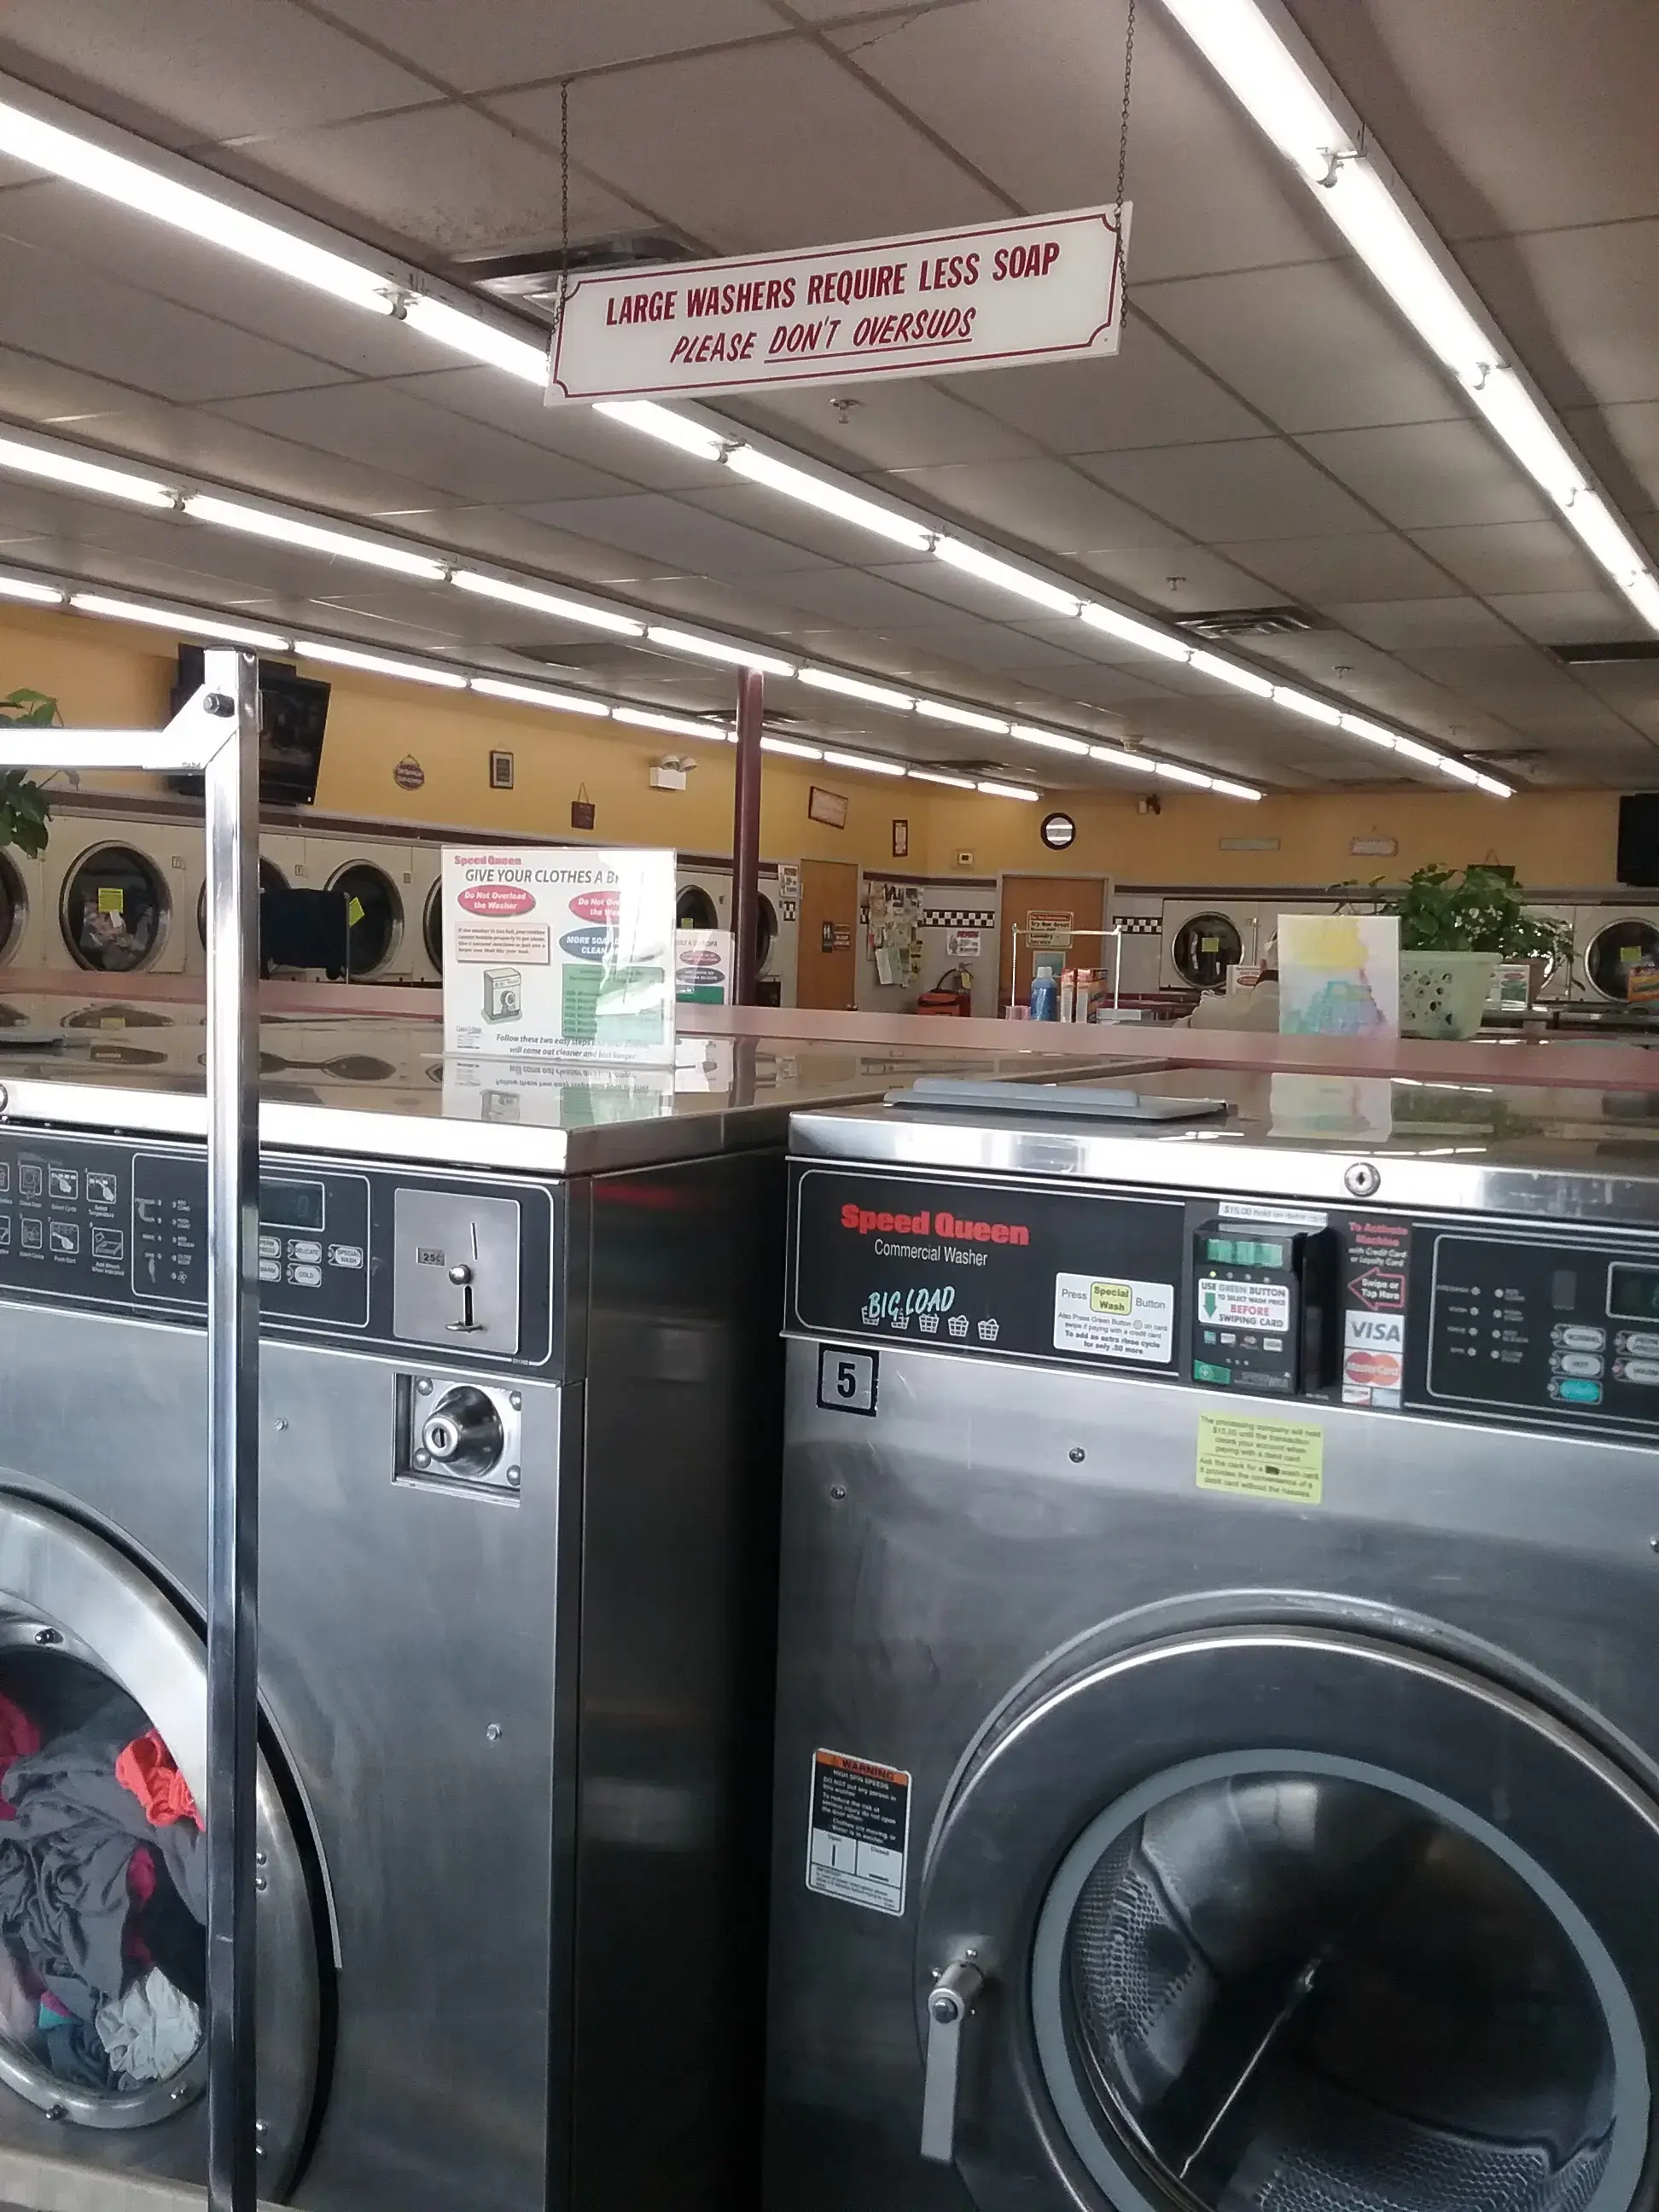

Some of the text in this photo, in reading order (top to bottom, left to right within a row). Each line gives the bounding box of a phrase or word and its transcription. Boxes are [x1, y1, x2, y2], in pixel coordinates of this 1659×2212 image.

[606, 242, 1060, 326] LARGE WASHERS REQUIRE LESS SOAP
[670, 307, 976, 364] PLEASE DON'T OVERSUDS
[455, 855, 521, 866] Speed Queen
[465, 869, 602, 883] GIVE YOUR CLOTHES A
[567, 935, 590, 944] MORE
[521, 1034, 538, 1044] these
[540, 1036, 553, 1045] two
[555, 1038, 570, 1047] easy
[613, 1052, 636, 1061] longer
[1225, 1206, 1251, 1215] $15.00
[841, 1203, 1030, 1245] Speed Queen
[295, 1248, 319, 1256] DELICATE
[423, 1253, 441, 1263] 25¢
[874, 1239, 987, 1266] Commercial Washer
[1220, 1284, 1246, 1293] GREEN
[1249, 1286, 1285, 1296] BUTTON
[867, 1286, 954, 1319] BIG LOAD
[1062, 1286, 1165, 1309] Press Special Button
[1099, 1301, 1125, 1311] Wash
[1231, 1304, 1269, 1316] BEFORE
[1220, 1313, 1283, 1327] SWIPING CARD
[1352, 1321, 1400, 1342] VISA
[1096, 1342, 1109, 1351] only
[1141, 1341, 1160, 1349] cycle
[837, 1361, 856, 1399] 5
[842, 1759, 894, 1780] WARNING
